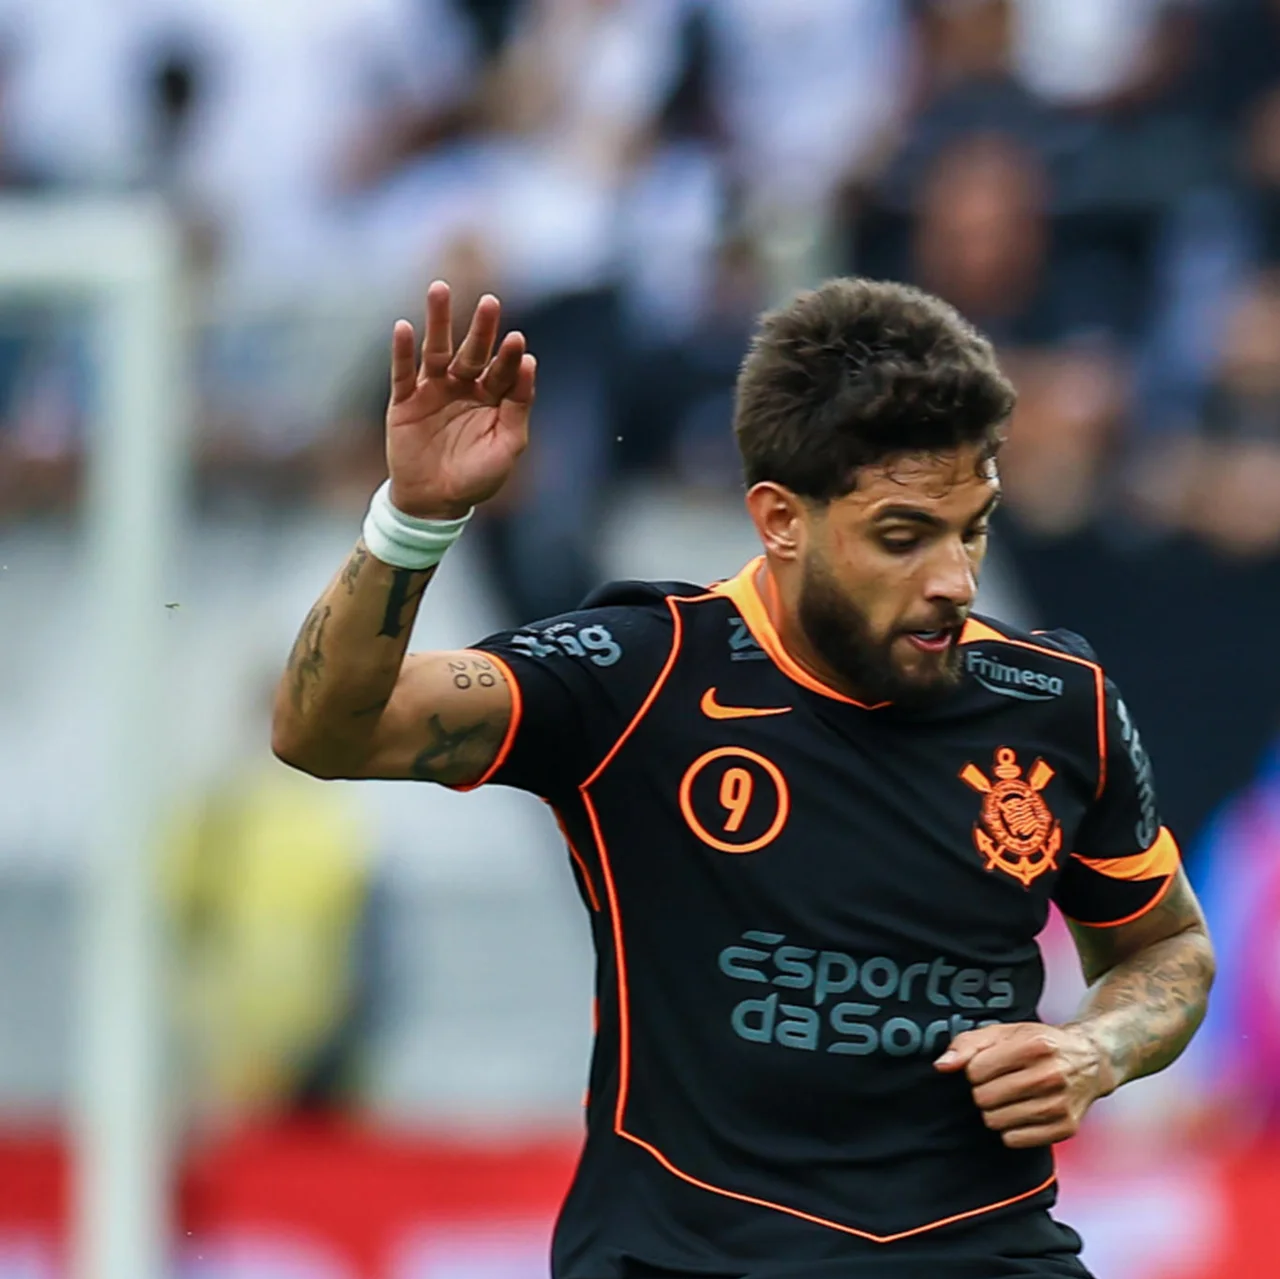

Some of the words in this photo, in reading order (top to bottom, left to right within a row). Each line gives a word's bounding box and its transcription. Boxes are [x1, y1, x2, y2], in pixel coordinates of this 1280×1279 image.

[967, 651, 1064, 696] Frimesa
[719, 767, 752, 832] 9
[718, 929, 1015, 1009] Esportes
[826, 1001, 1004, 1057] Sort
